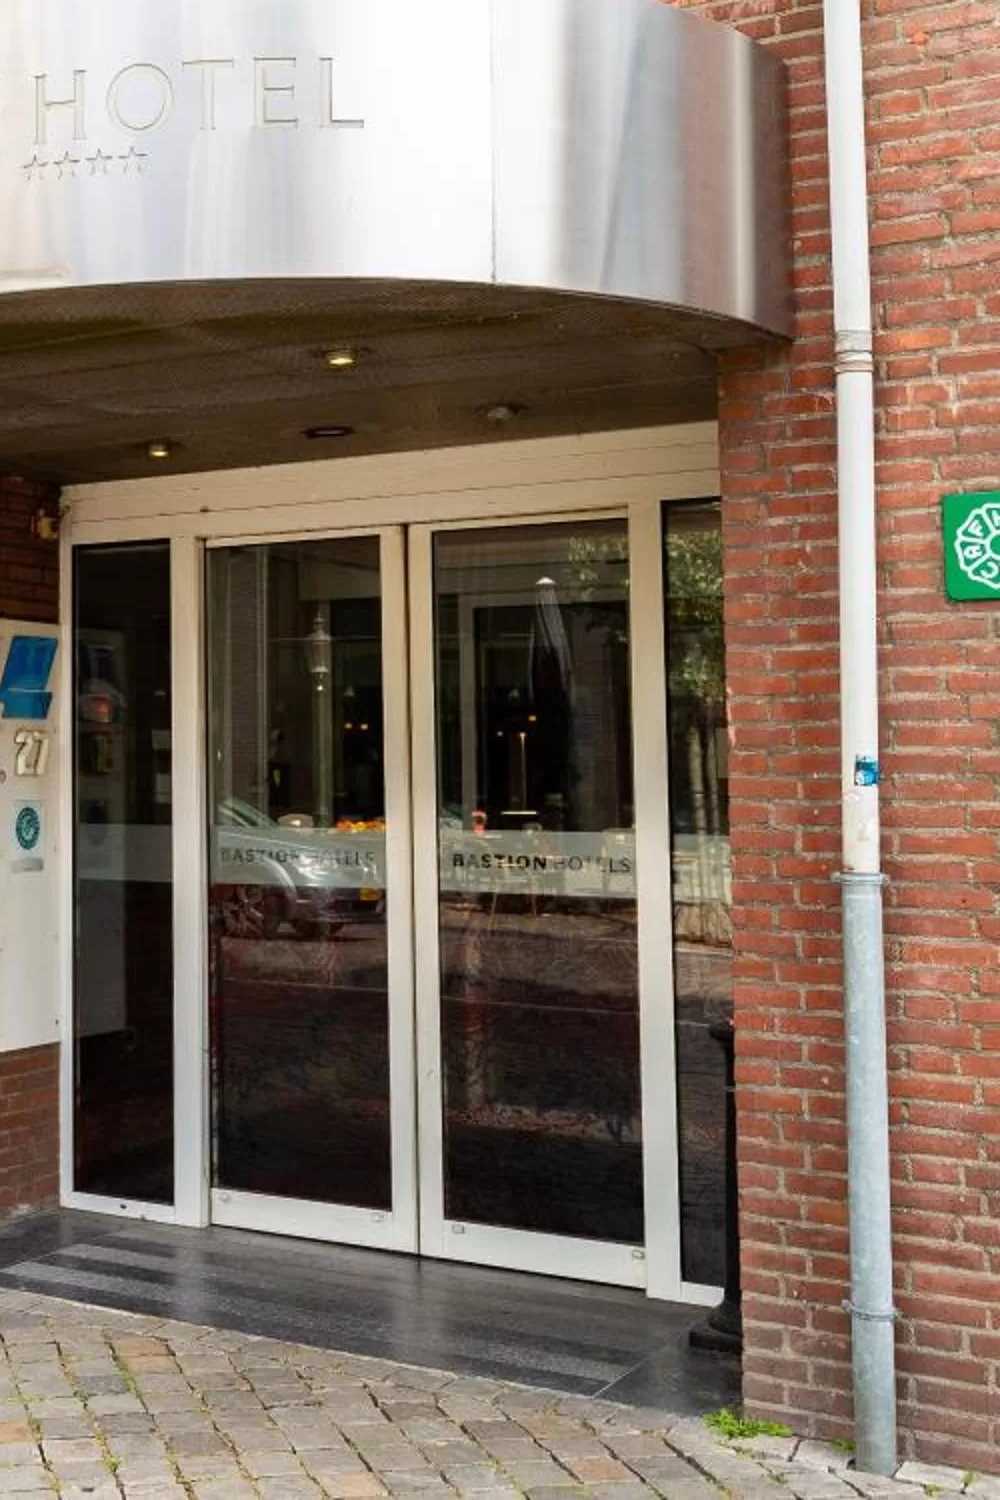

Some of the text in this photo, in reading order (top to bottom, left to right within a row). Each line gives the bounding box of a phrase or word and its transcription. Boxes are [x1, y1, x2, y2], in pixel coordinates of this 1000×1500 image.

[31, 56, 365, 146] HOTEL
[452, 852, 633, 874] BASTION HOLS
